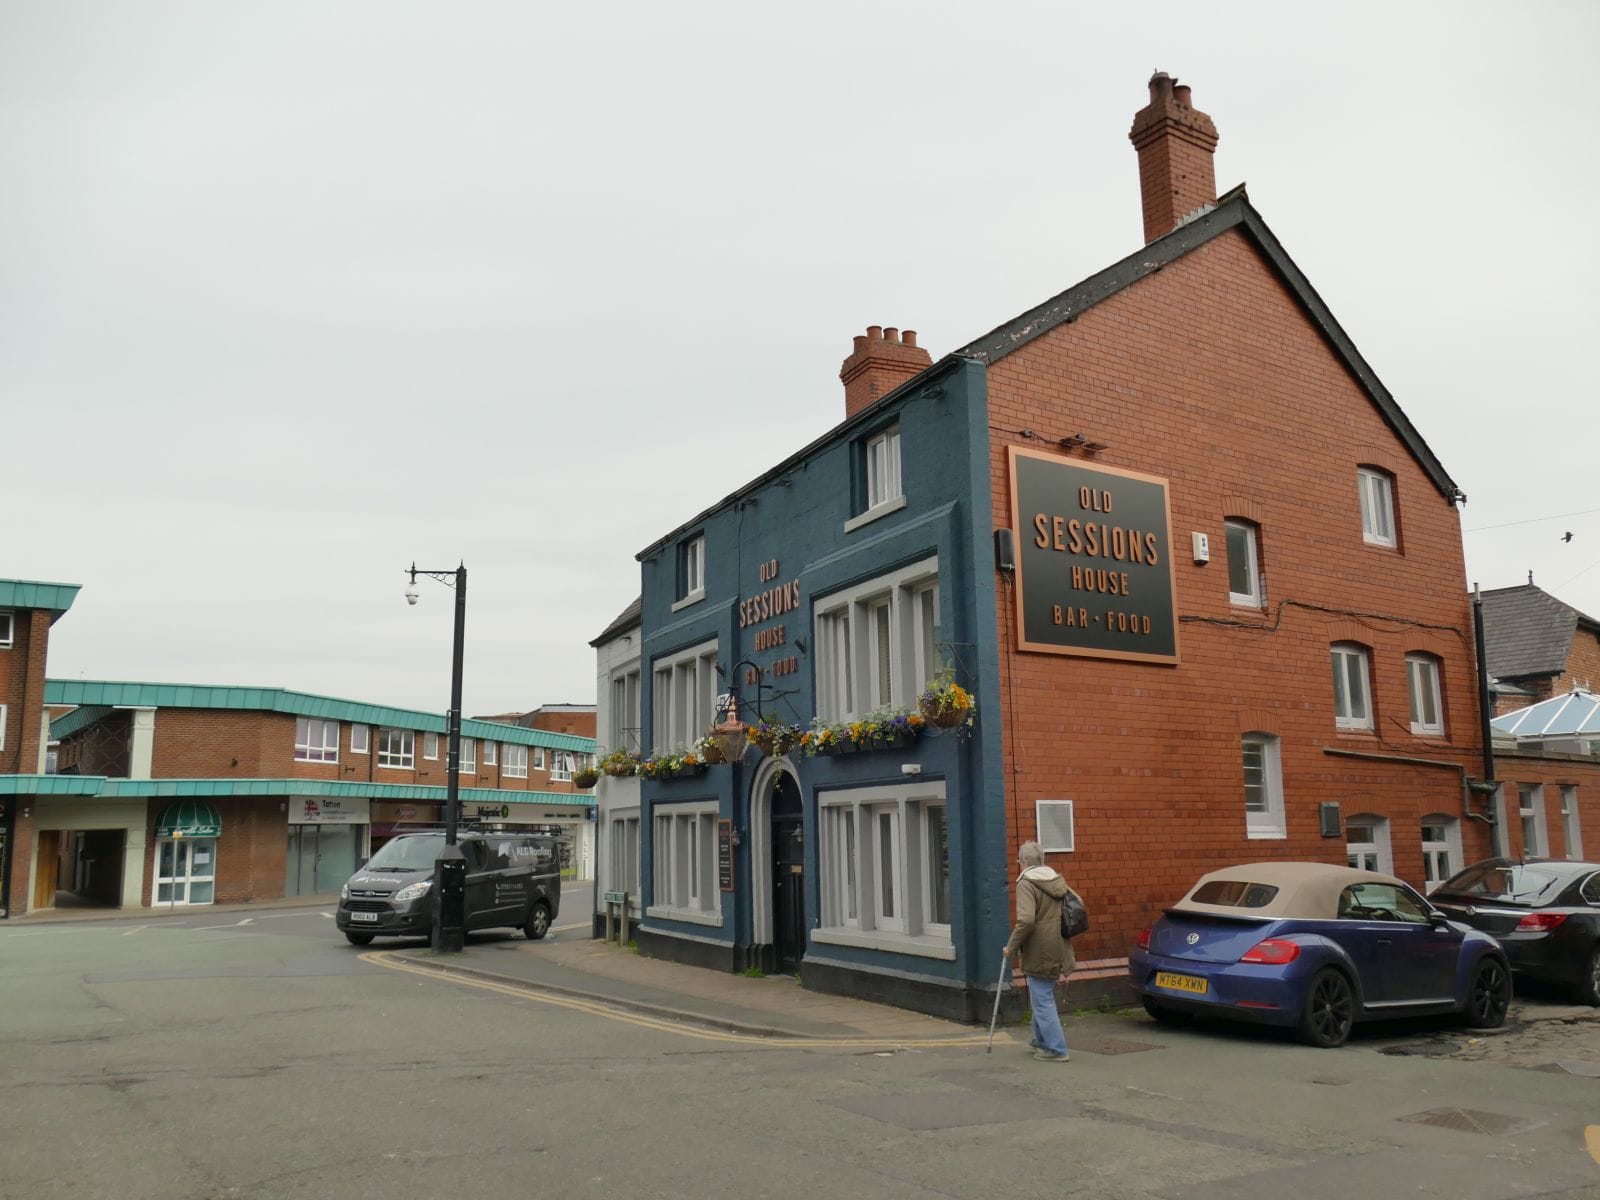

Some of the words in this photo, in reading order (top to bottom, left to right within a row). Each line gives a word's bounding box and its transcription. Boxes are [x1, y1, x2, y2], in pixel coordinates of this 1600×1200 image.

[1079, 486, 1112, 513] OLD
[1034, 513, 1159, 566] SESSIONS
[760, 559, 778, 583] OLD
[1071, 566, 1129, 596] HOUSE
[739, 578, 800, 628] SESSIONS
[1053, 605, 1088, 628] BAR
[1106, 611, 1151, 634] FOOD
[755, 624, 785, 652] HOUSE
[771, 655, 797, 677] FOOD
